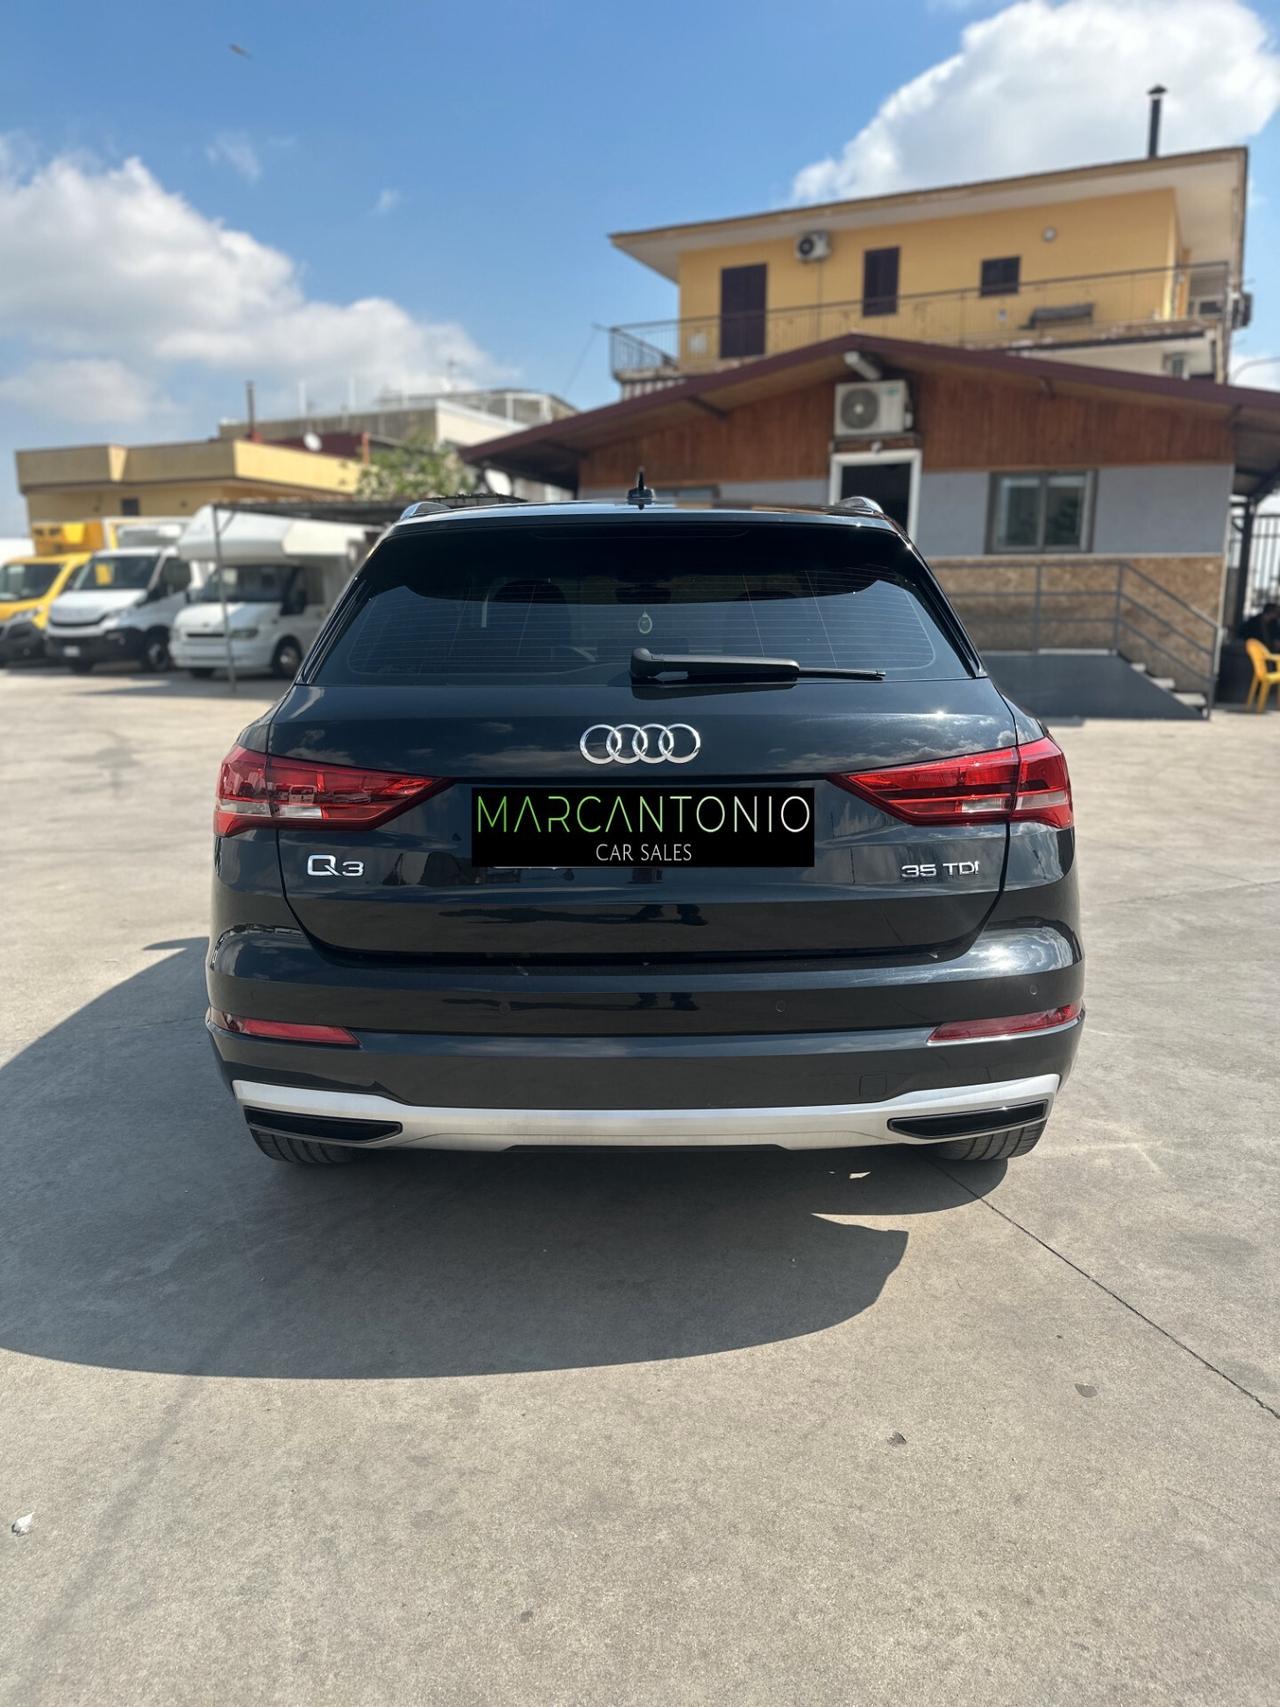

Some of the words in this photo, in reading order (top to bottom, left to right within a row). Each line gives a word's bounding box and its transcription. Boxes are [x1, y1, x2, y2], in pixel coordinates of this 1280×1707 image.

[307, 854, 364, 877] Q3
[901, 863, 937, 878] 35
[942, 860, 980, 876] TDI
